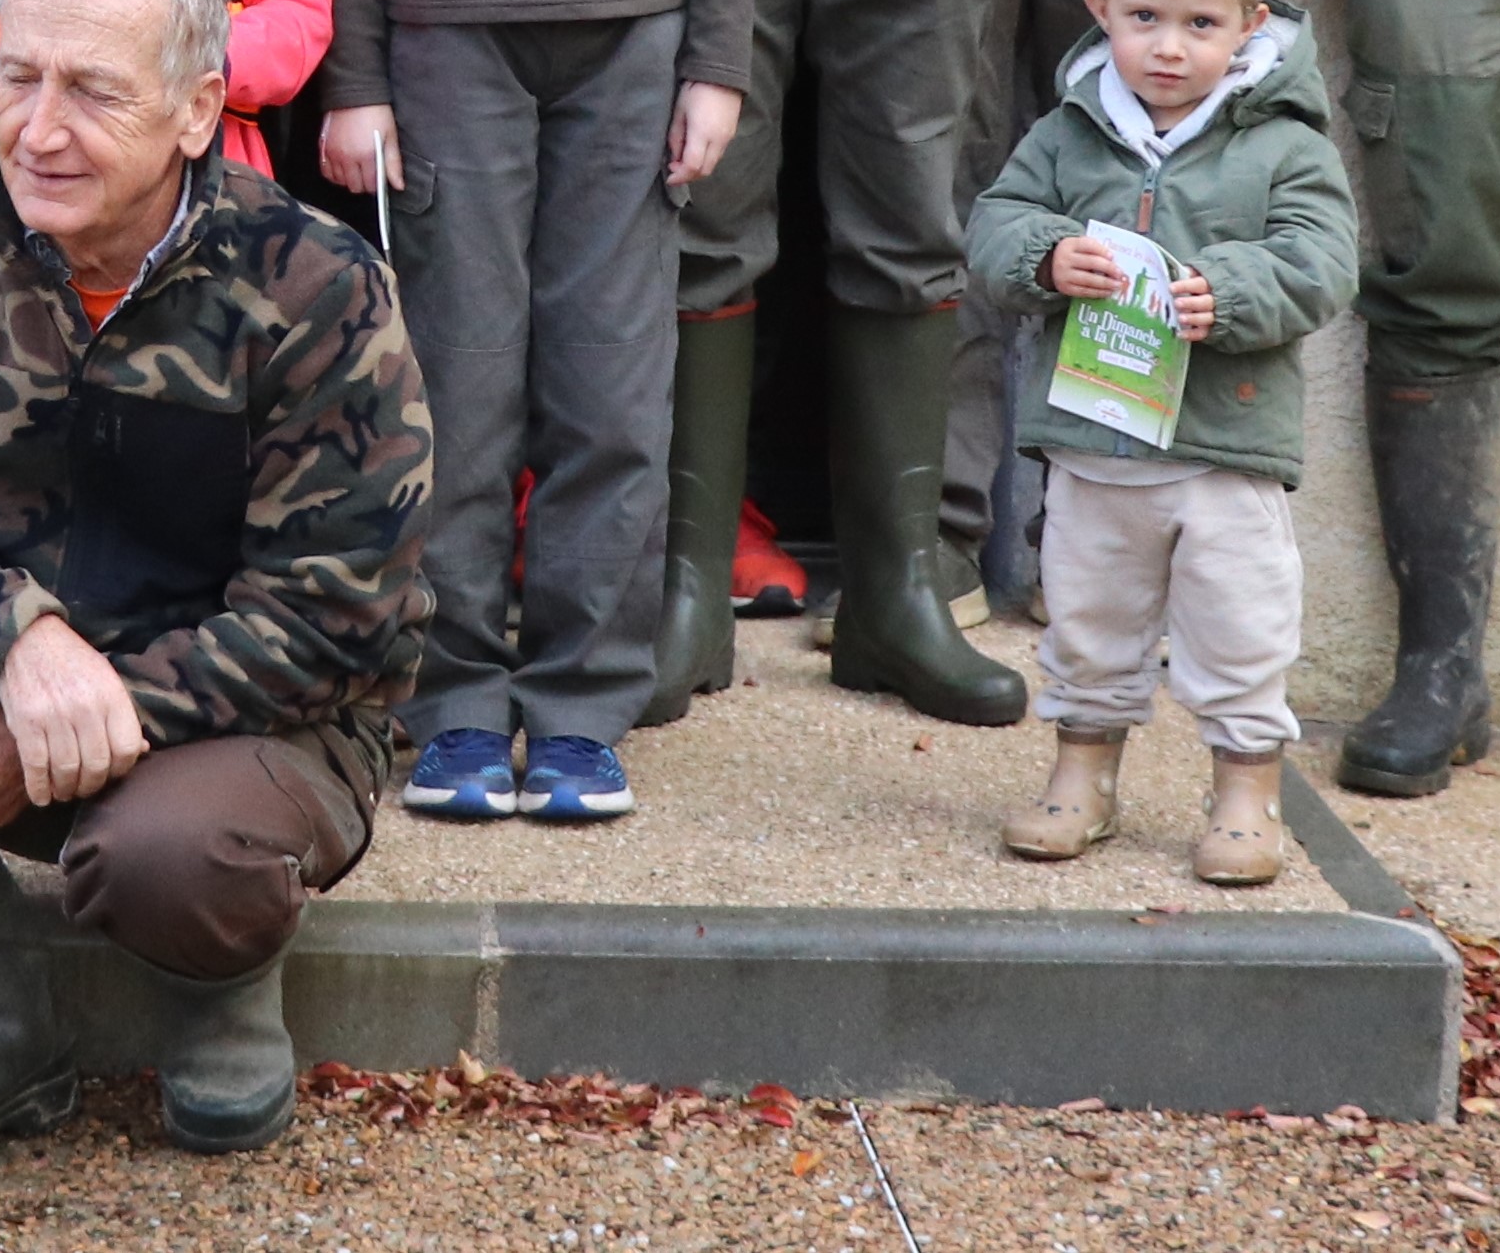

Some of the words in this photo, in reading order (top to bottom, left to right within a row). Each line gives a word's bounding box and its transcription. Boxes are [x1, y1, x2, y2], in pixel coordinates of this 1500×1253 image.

[1078, 303, 1098, 326] Un
[1099, 310, 1162, 350] Dimanche
[1110, 332, 1155, 361] Chasse
